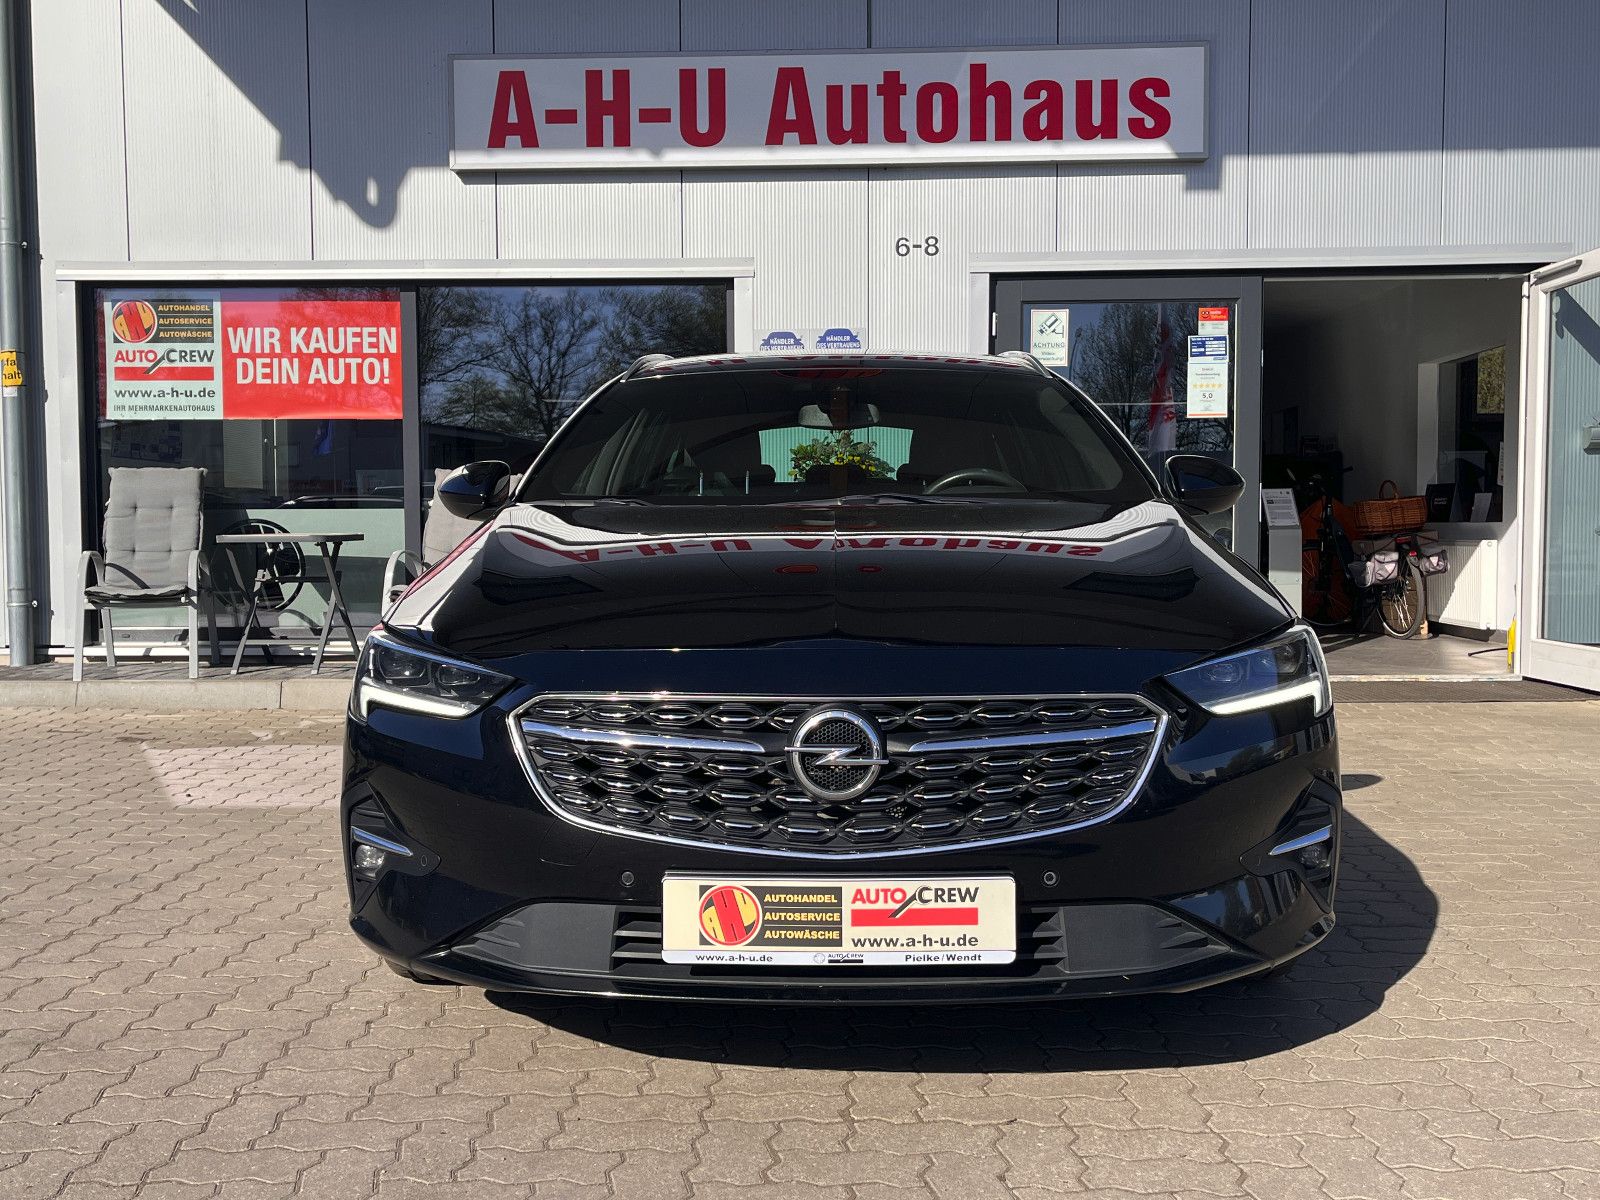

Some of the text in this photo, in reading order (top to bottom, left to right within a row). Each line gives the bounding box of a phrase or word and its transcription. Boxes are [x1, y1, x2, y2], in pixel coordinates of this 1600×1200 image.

[487, 63, 1171, 148] A-H-U Autohaus
[895, 236, 940, 256] 6-8
[159, 330, 213, 338] AUTOWÄSCHE
[826, 334, 851, 342] HÄNDLER
[227, 327, 397, 354] WIR KAUFEN
[828, 341, 860, 349] VERTRAUENS
[114, 349, 215, 363] AUTO CREW
[236, 357, 390, 385] DEIN AUTO!
[114, 387, 216, 398] www.a-h-u.de
[764, 894, 838, 903] AUTOHANDEL
[851, 886, 979, 905] AUTO CREW
[764, 912, 841, 921] AUTOSERVICE
[764, 929, 840, 940] AUTOWÄSCHE
[851, 934, 979, 948] www.a-h-u.de
[695, 954, 773, 963] www.a-h-u.de
